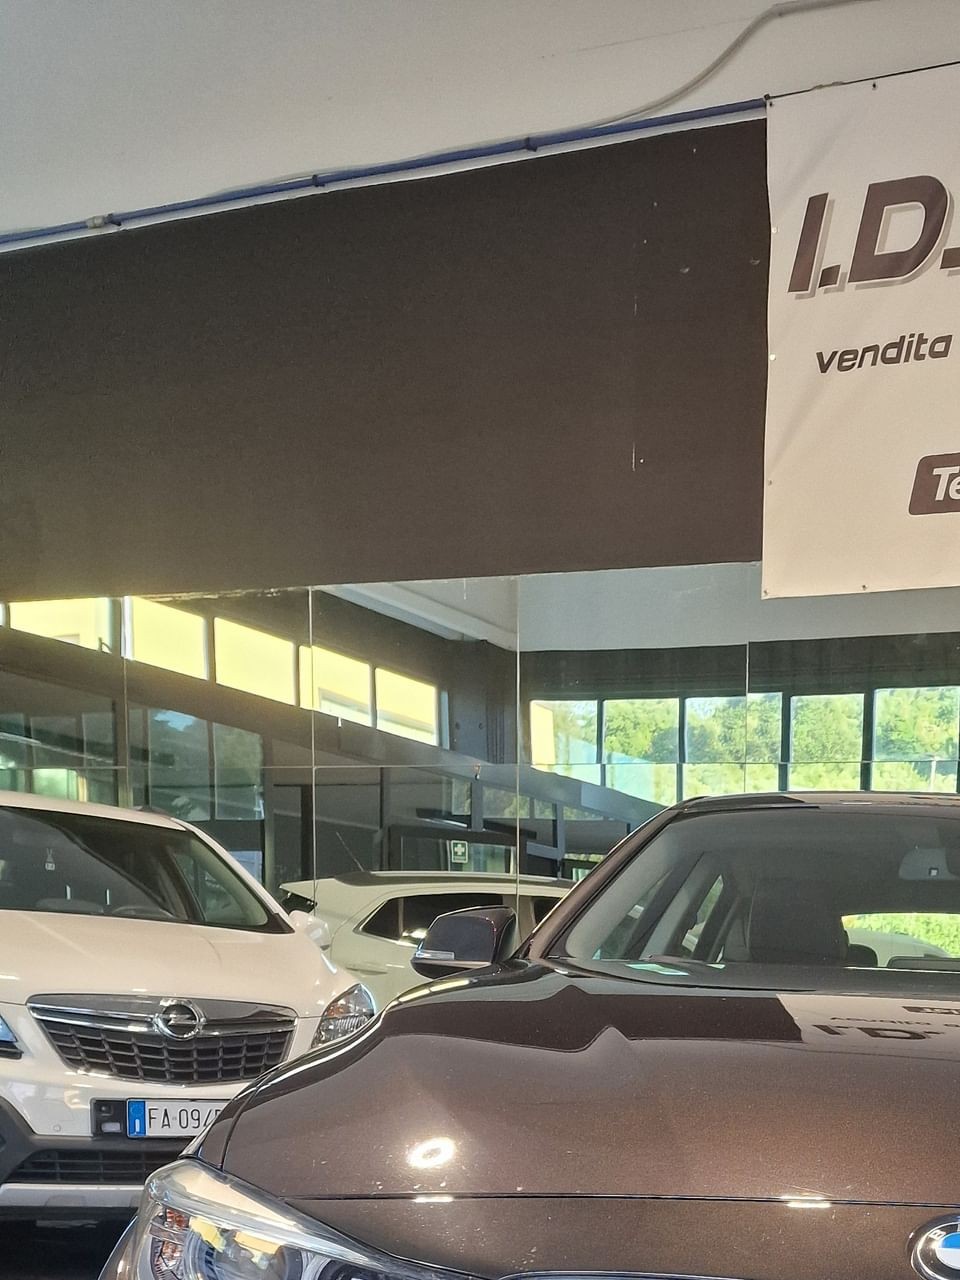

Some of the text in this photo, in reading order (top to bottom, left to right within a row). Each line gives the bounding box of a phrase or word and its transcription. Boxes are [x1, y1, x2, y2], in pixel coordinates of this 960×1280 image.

[815, 333, 953, 374] vendita
[148, 1107, 171, 1129] FA
[178, 1108, 222, 1129] 09
